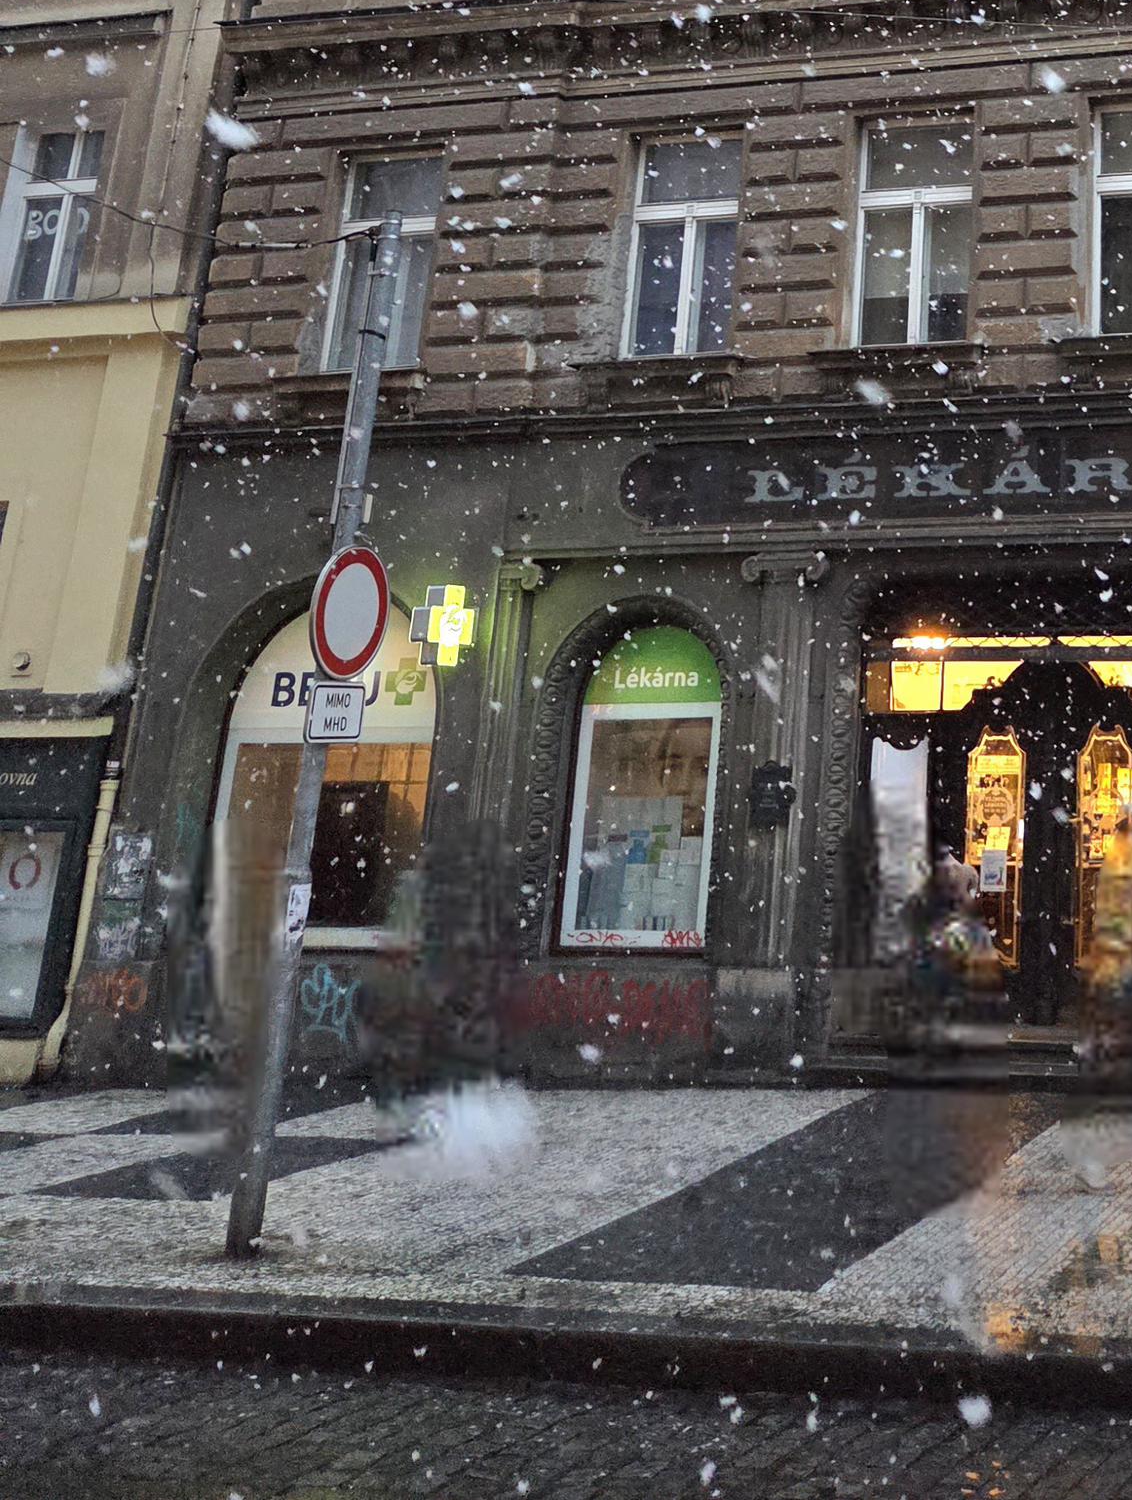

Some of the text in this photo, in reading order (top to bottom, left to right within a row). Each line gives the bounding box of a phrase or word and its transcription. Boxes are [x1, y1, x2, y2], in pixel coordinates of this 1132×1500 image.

[613, 666, 699, 689] Lékárna
[271, 671, 381, 707] BEU
[325, 693, 351, 708] MIMO
[323, 716, 347, 732] MHD
